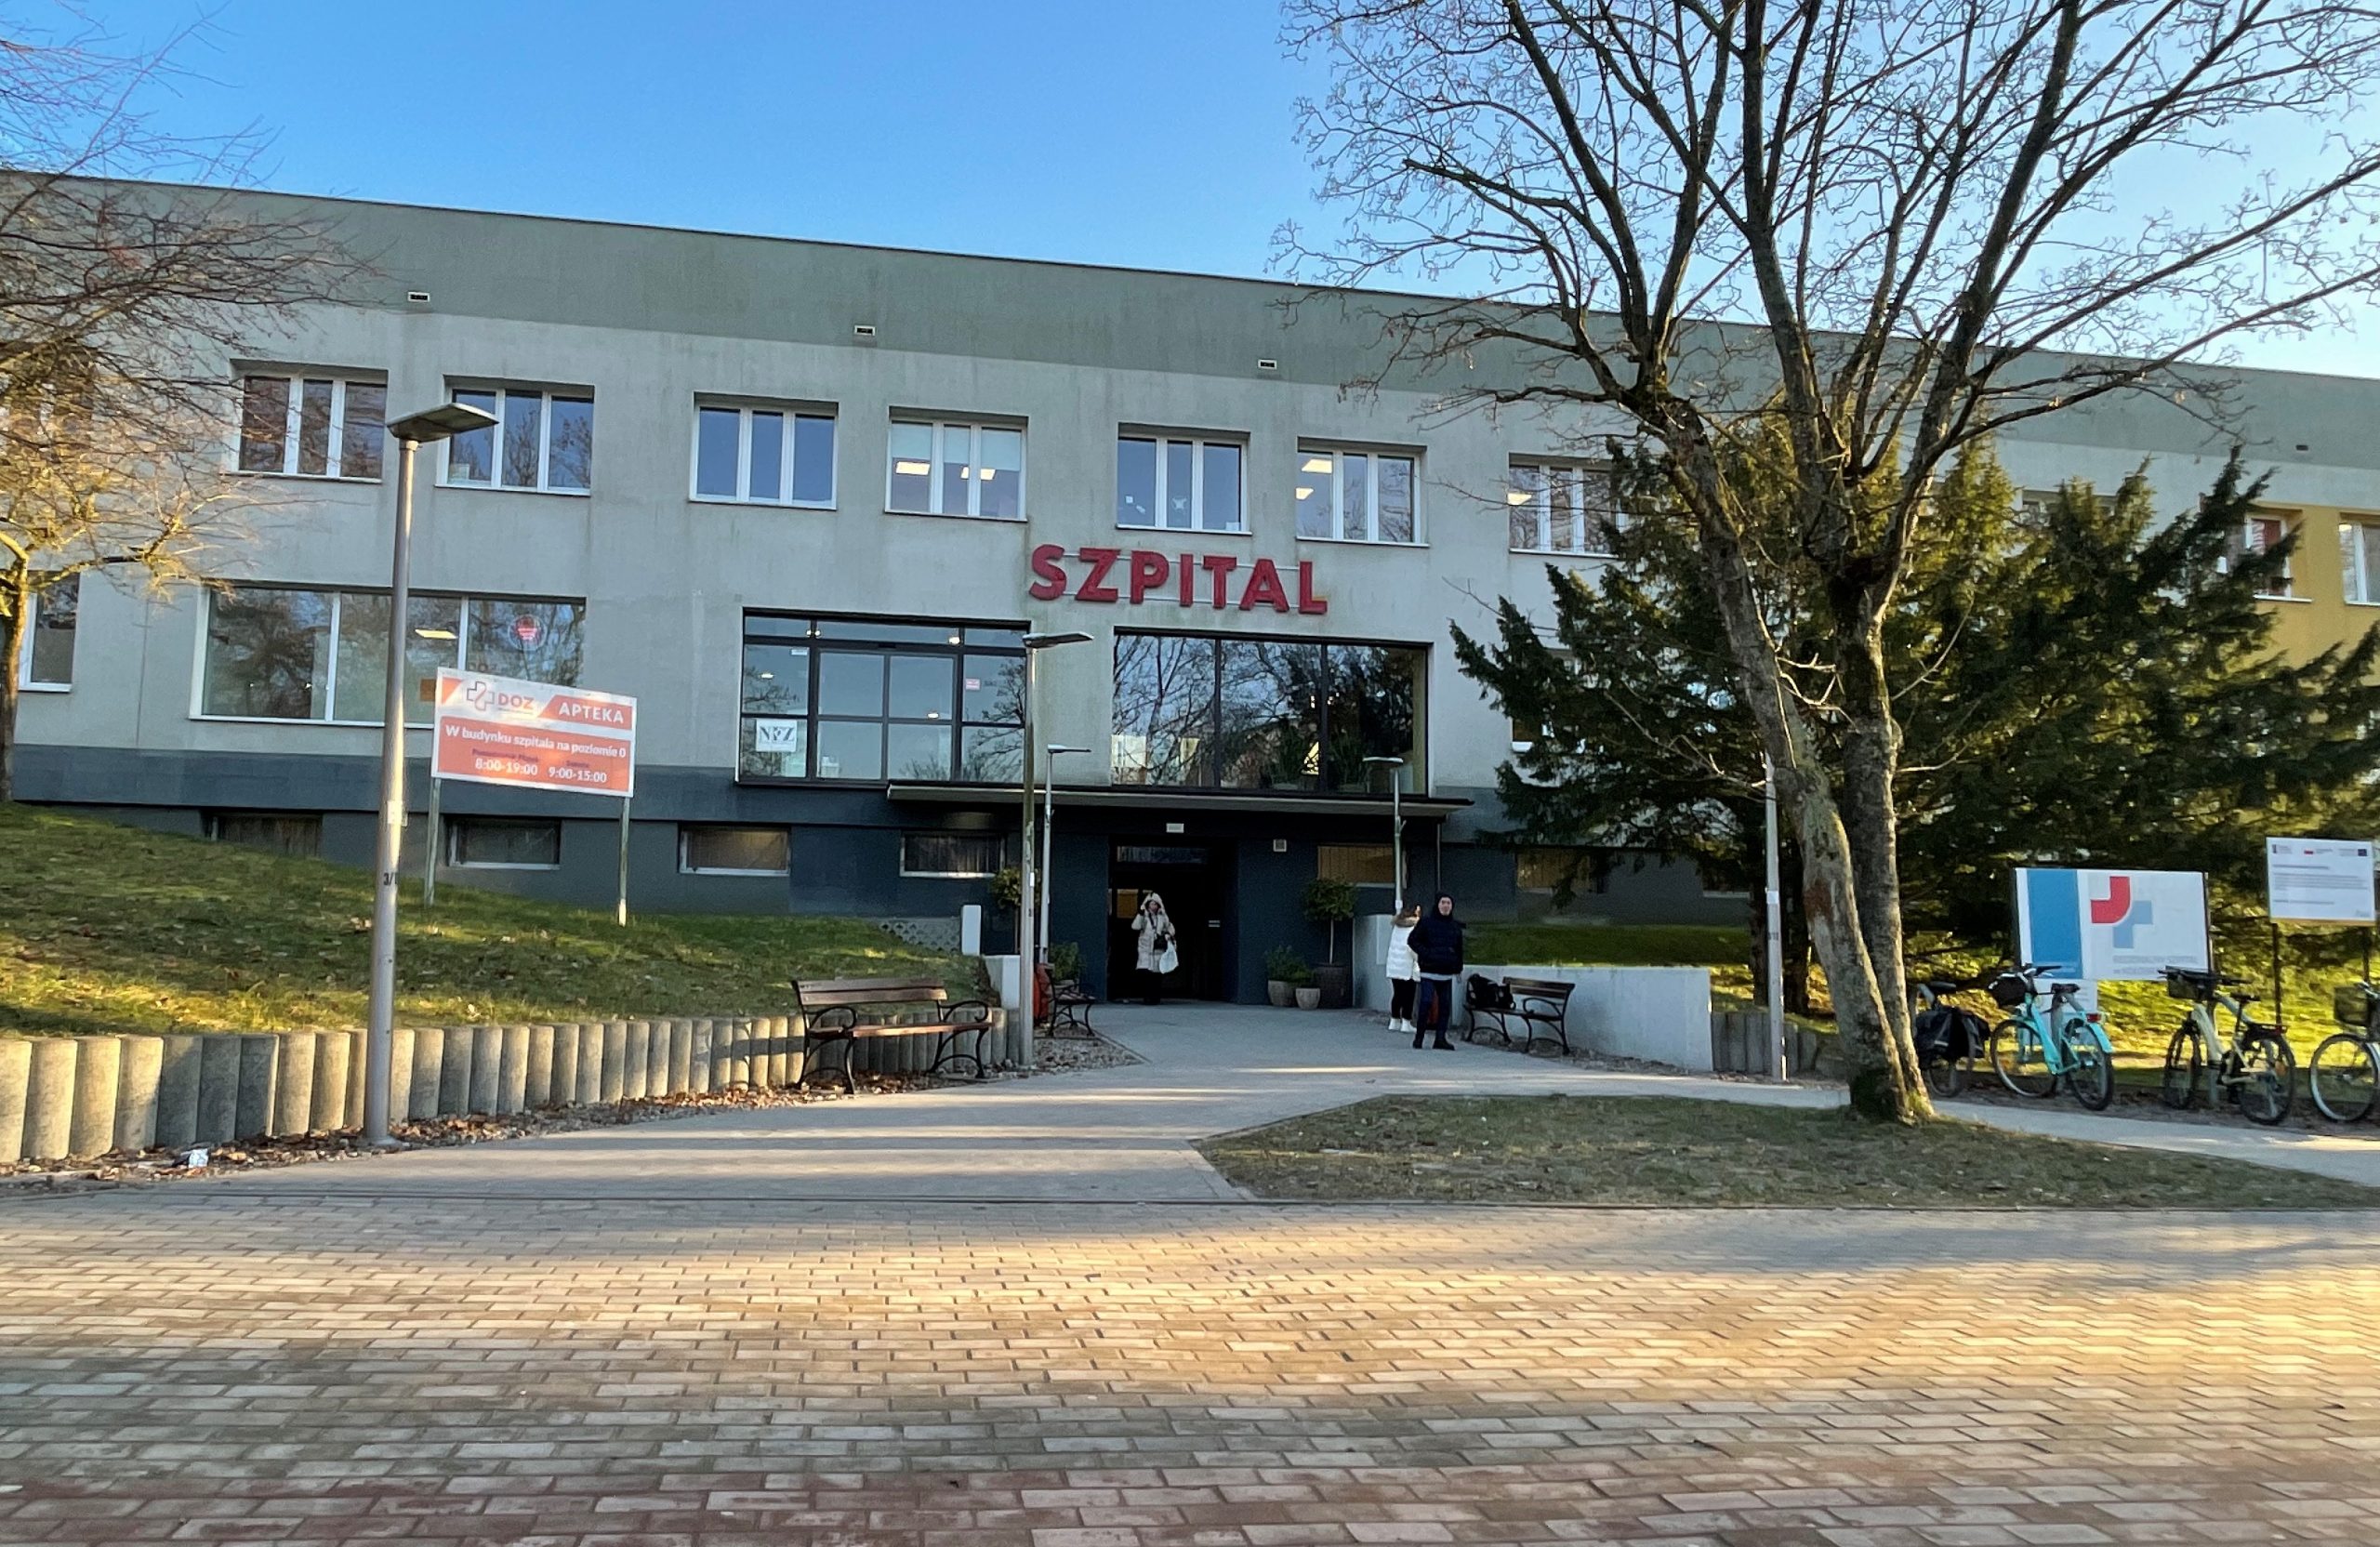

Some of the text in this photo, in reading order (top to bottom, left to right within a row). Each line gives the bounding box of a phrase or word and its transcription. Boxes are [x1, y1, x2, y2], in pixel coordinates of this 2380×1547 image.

[1029, 544, 1328, 615] SZPITAL
[498, 693, 535, 709] DOZ
[559, 702, 624, 723] APTEKA
[446, 725, 626, 758] W budynku szpitala na poziomie 0
[475, 758, 607, 783] 8:00-19:00 9:00-15:00
